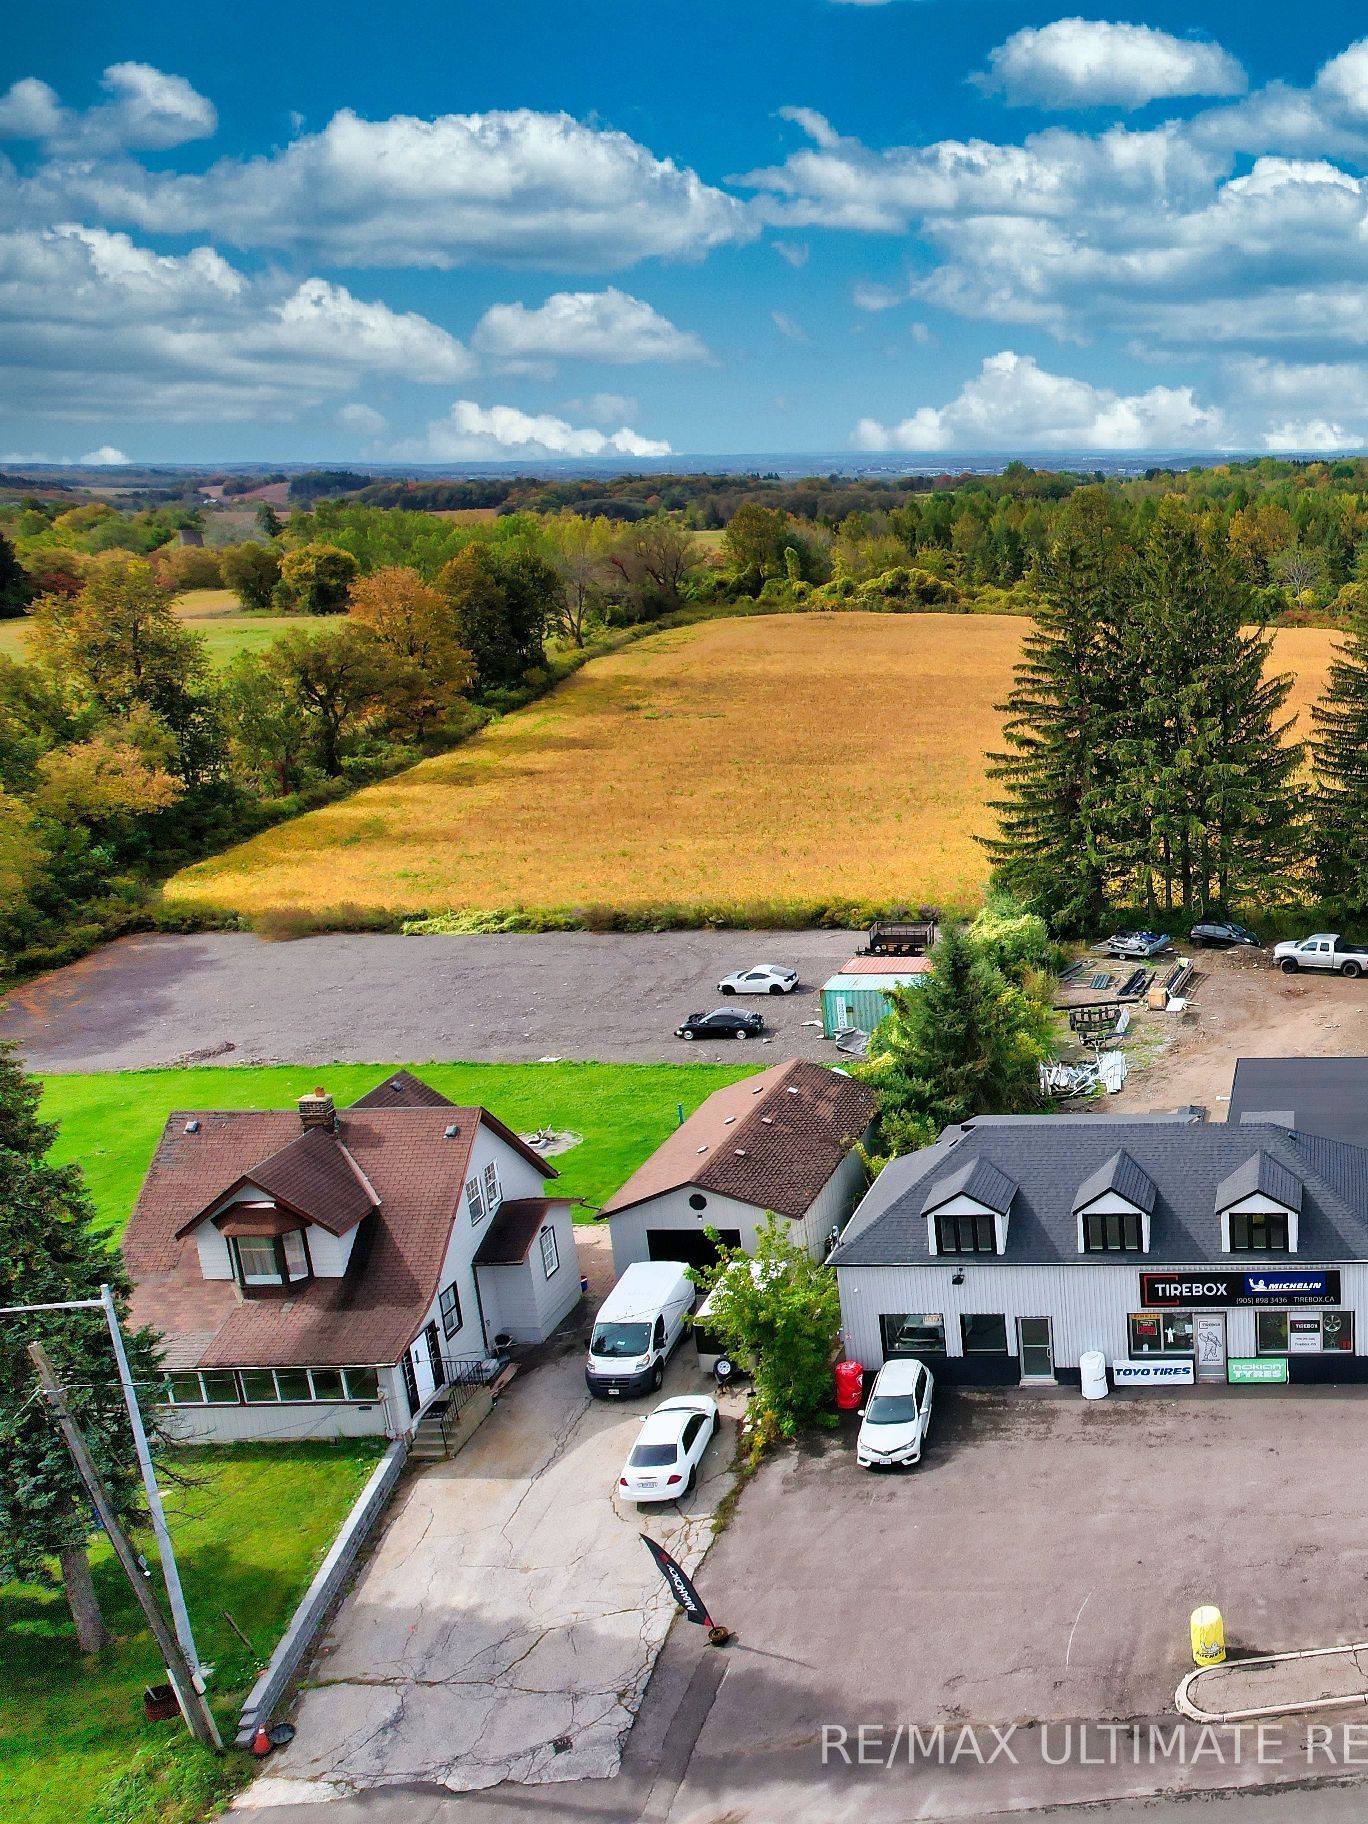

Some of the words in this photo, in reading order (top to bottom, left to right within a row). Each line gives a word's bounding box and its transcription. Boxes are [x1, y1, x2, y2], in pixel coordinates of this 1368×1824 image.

[1154, 1283, 1228, 1297] TIREBOX
[1268, 1282, 1322, 1290] MICHELIN
[1236, 1297, 1254, 1305] (905)
[1115, 1368, 1151, 1376] TOYO
[1152, 1367, 1191, 1375] TIRES
[1233, 1369, 1282, 1378] TYRES
